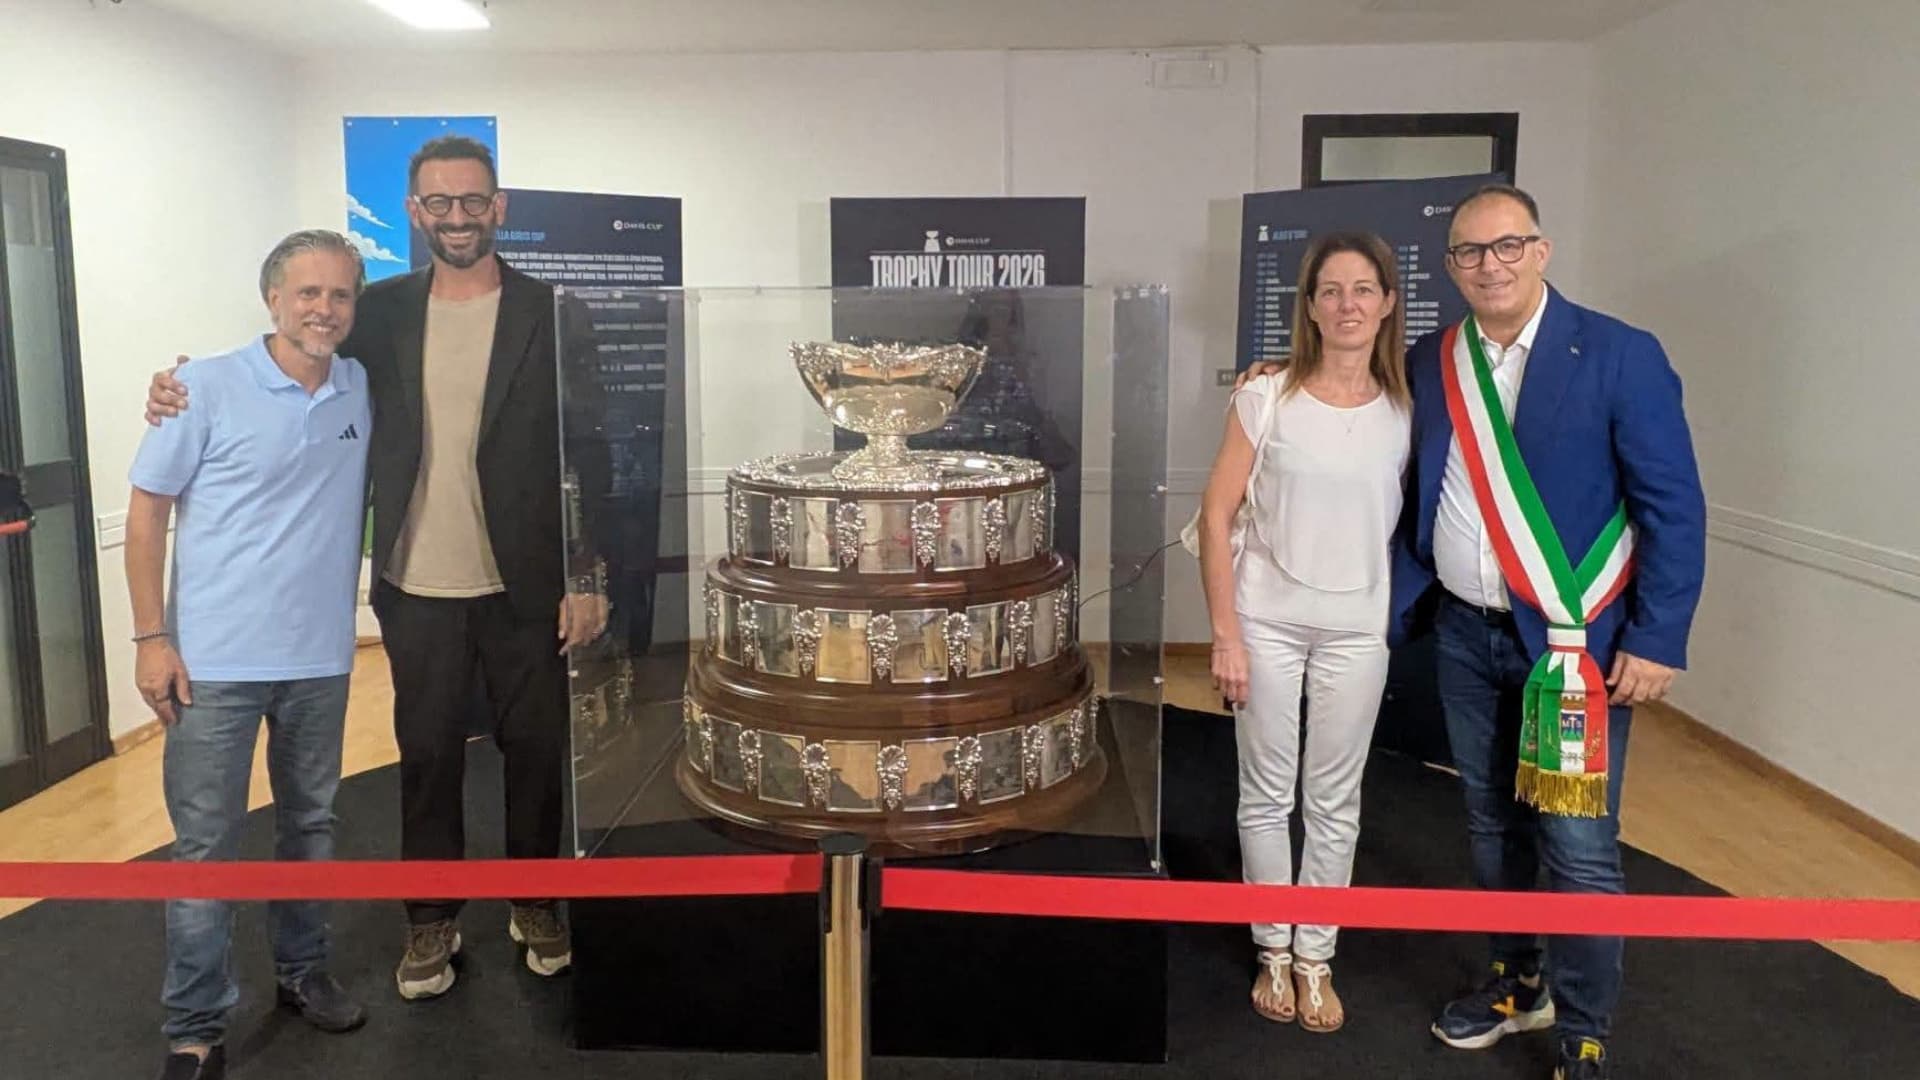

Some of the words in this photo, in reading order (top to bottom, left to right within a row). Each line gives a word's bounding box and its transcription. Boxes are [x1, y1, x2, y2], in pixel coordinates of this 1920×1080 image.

[869, 254, 944, 288] TROPHY
[946, 254, 995, 288] TOUR
[998, 254, 1046, 288] 2026
